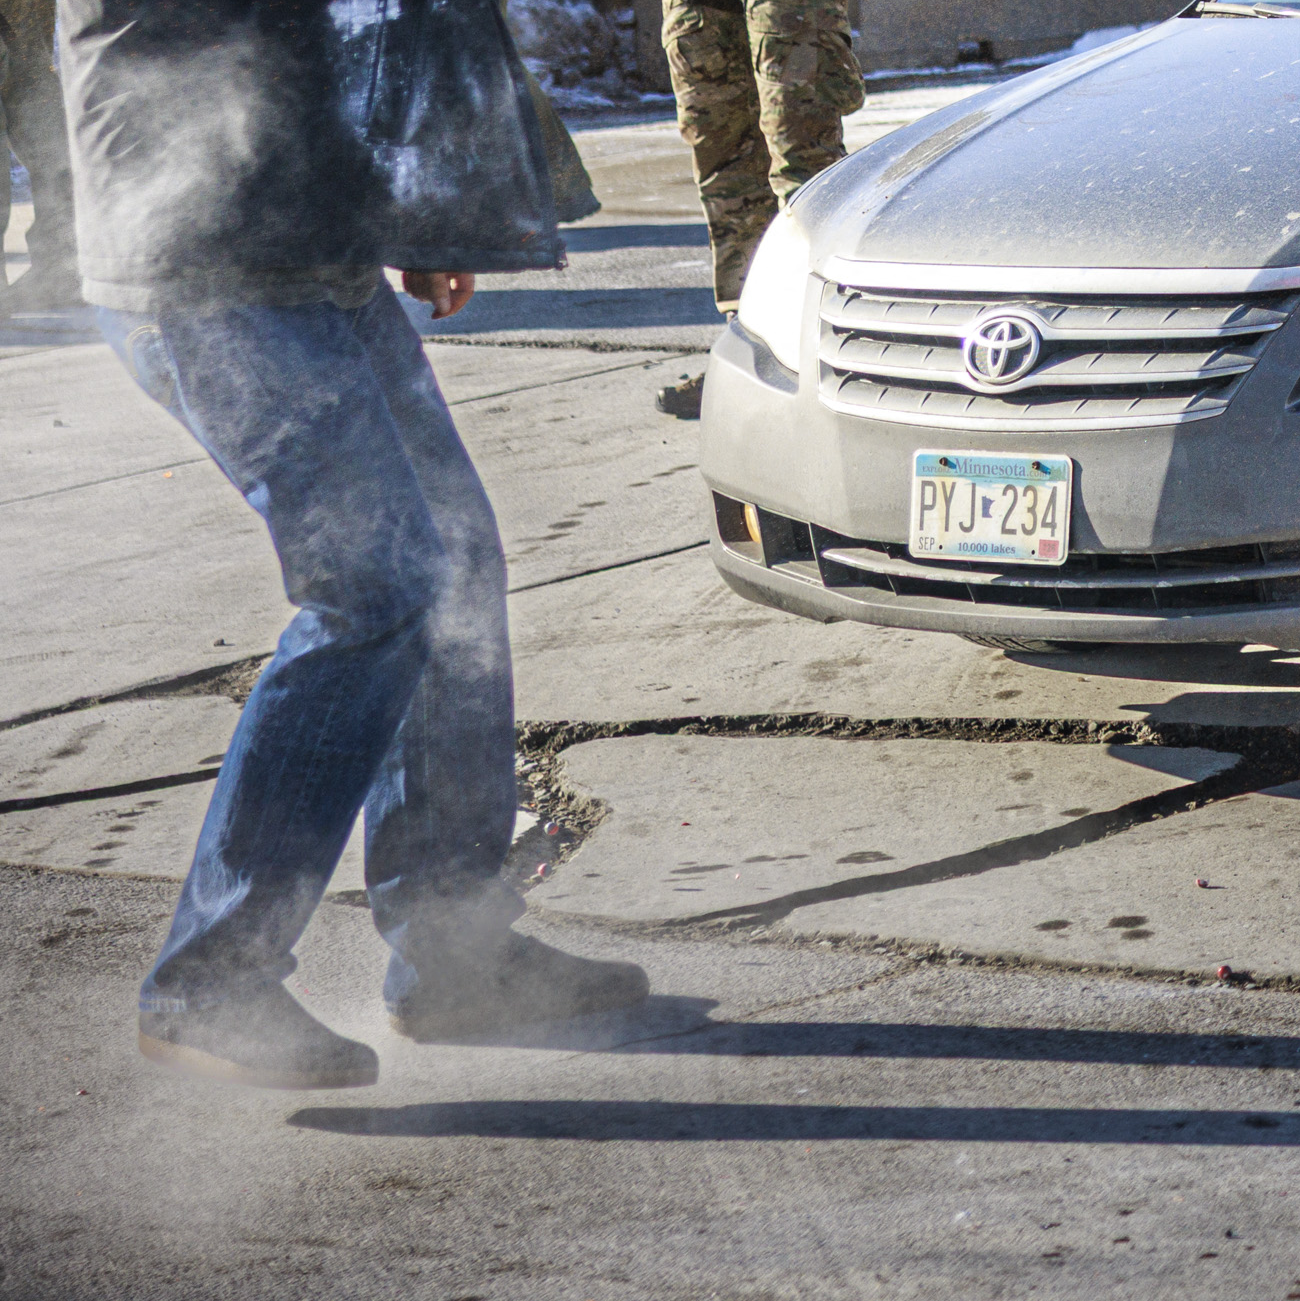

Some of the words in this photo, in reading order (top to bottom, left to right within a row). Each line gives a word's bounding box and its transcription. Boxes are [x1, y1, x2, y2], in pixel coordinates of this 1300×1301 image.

[918, 480, 977, 534] PYJ
[1000, 484, 1058, 537] 234
[918, 536, 935, 551] SEP
[958, 542, 988, 553] 10,000
[991, 543, 1016, 555] lakes
